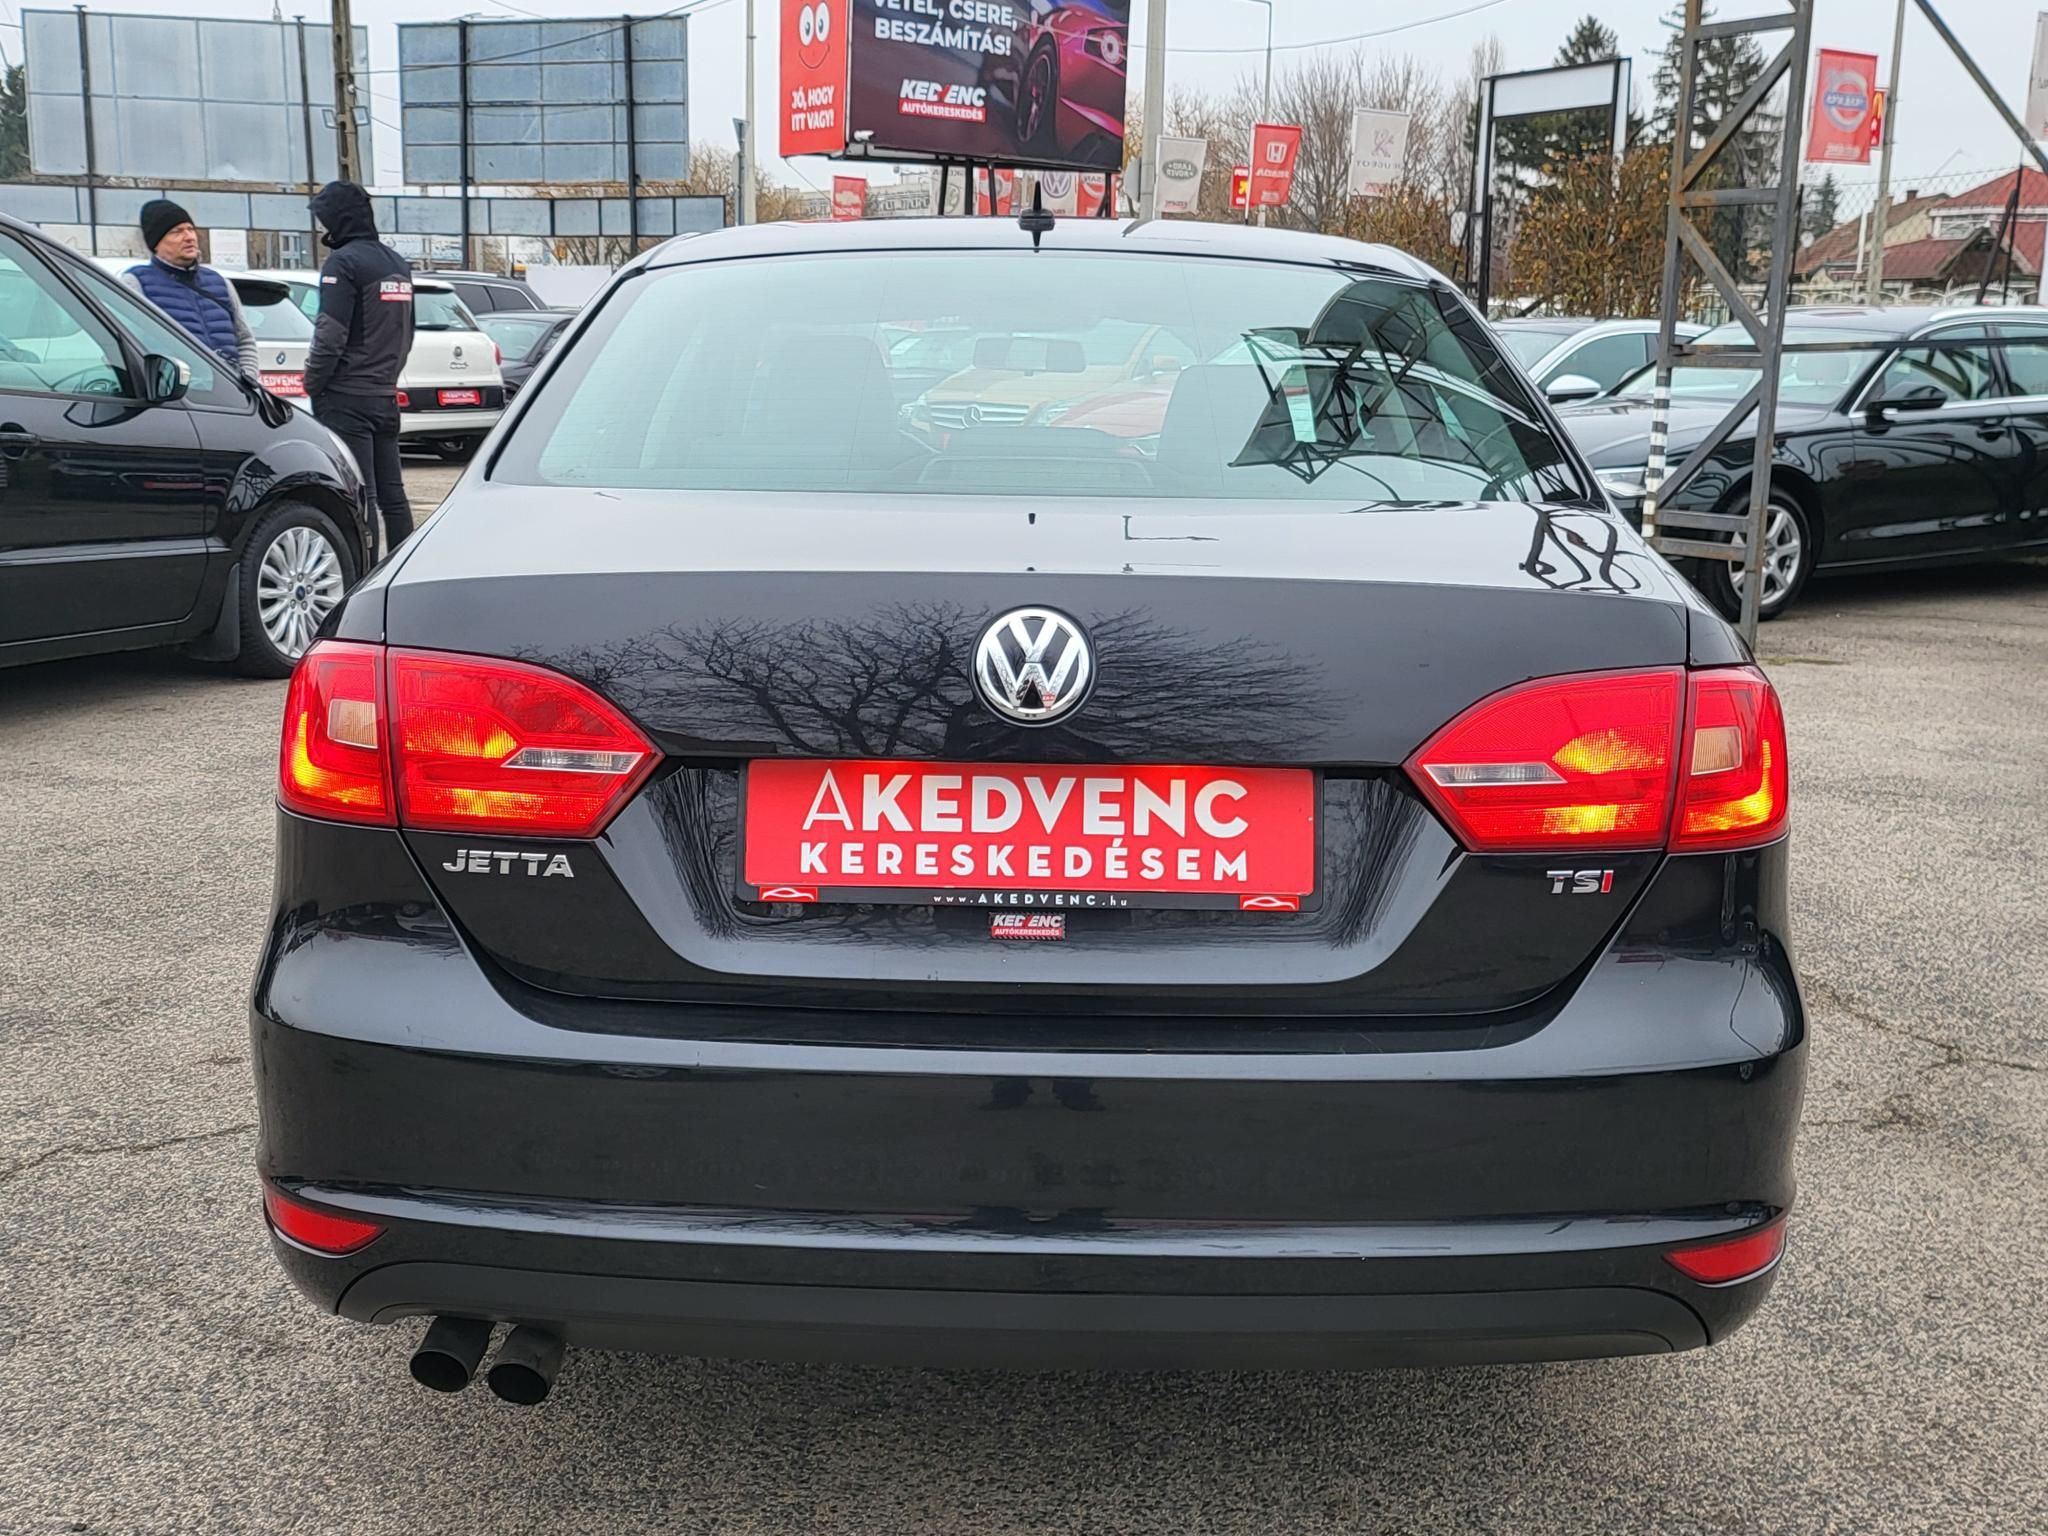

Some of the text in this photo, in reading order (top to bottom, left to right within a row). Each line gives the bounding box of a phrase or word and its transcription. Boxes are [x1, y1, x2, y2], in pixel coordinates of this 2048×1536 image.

[949, 0, 1017, 31] CSERE,
[875, 17, 1011, 56] BESZÁMÍTÁS!
[792, 86, 834, 110] JÓ, HOGY
[901, 102, 983, 120] AUTÓKERESKEDÉS
[792, 109, 834, 131] ITT VAGY!
[442, 849, 575, 878] JETTA
[800, 837, 1248, 881] KERESKEDÉSEM
[1546, 869, 1614, 894] TSI
